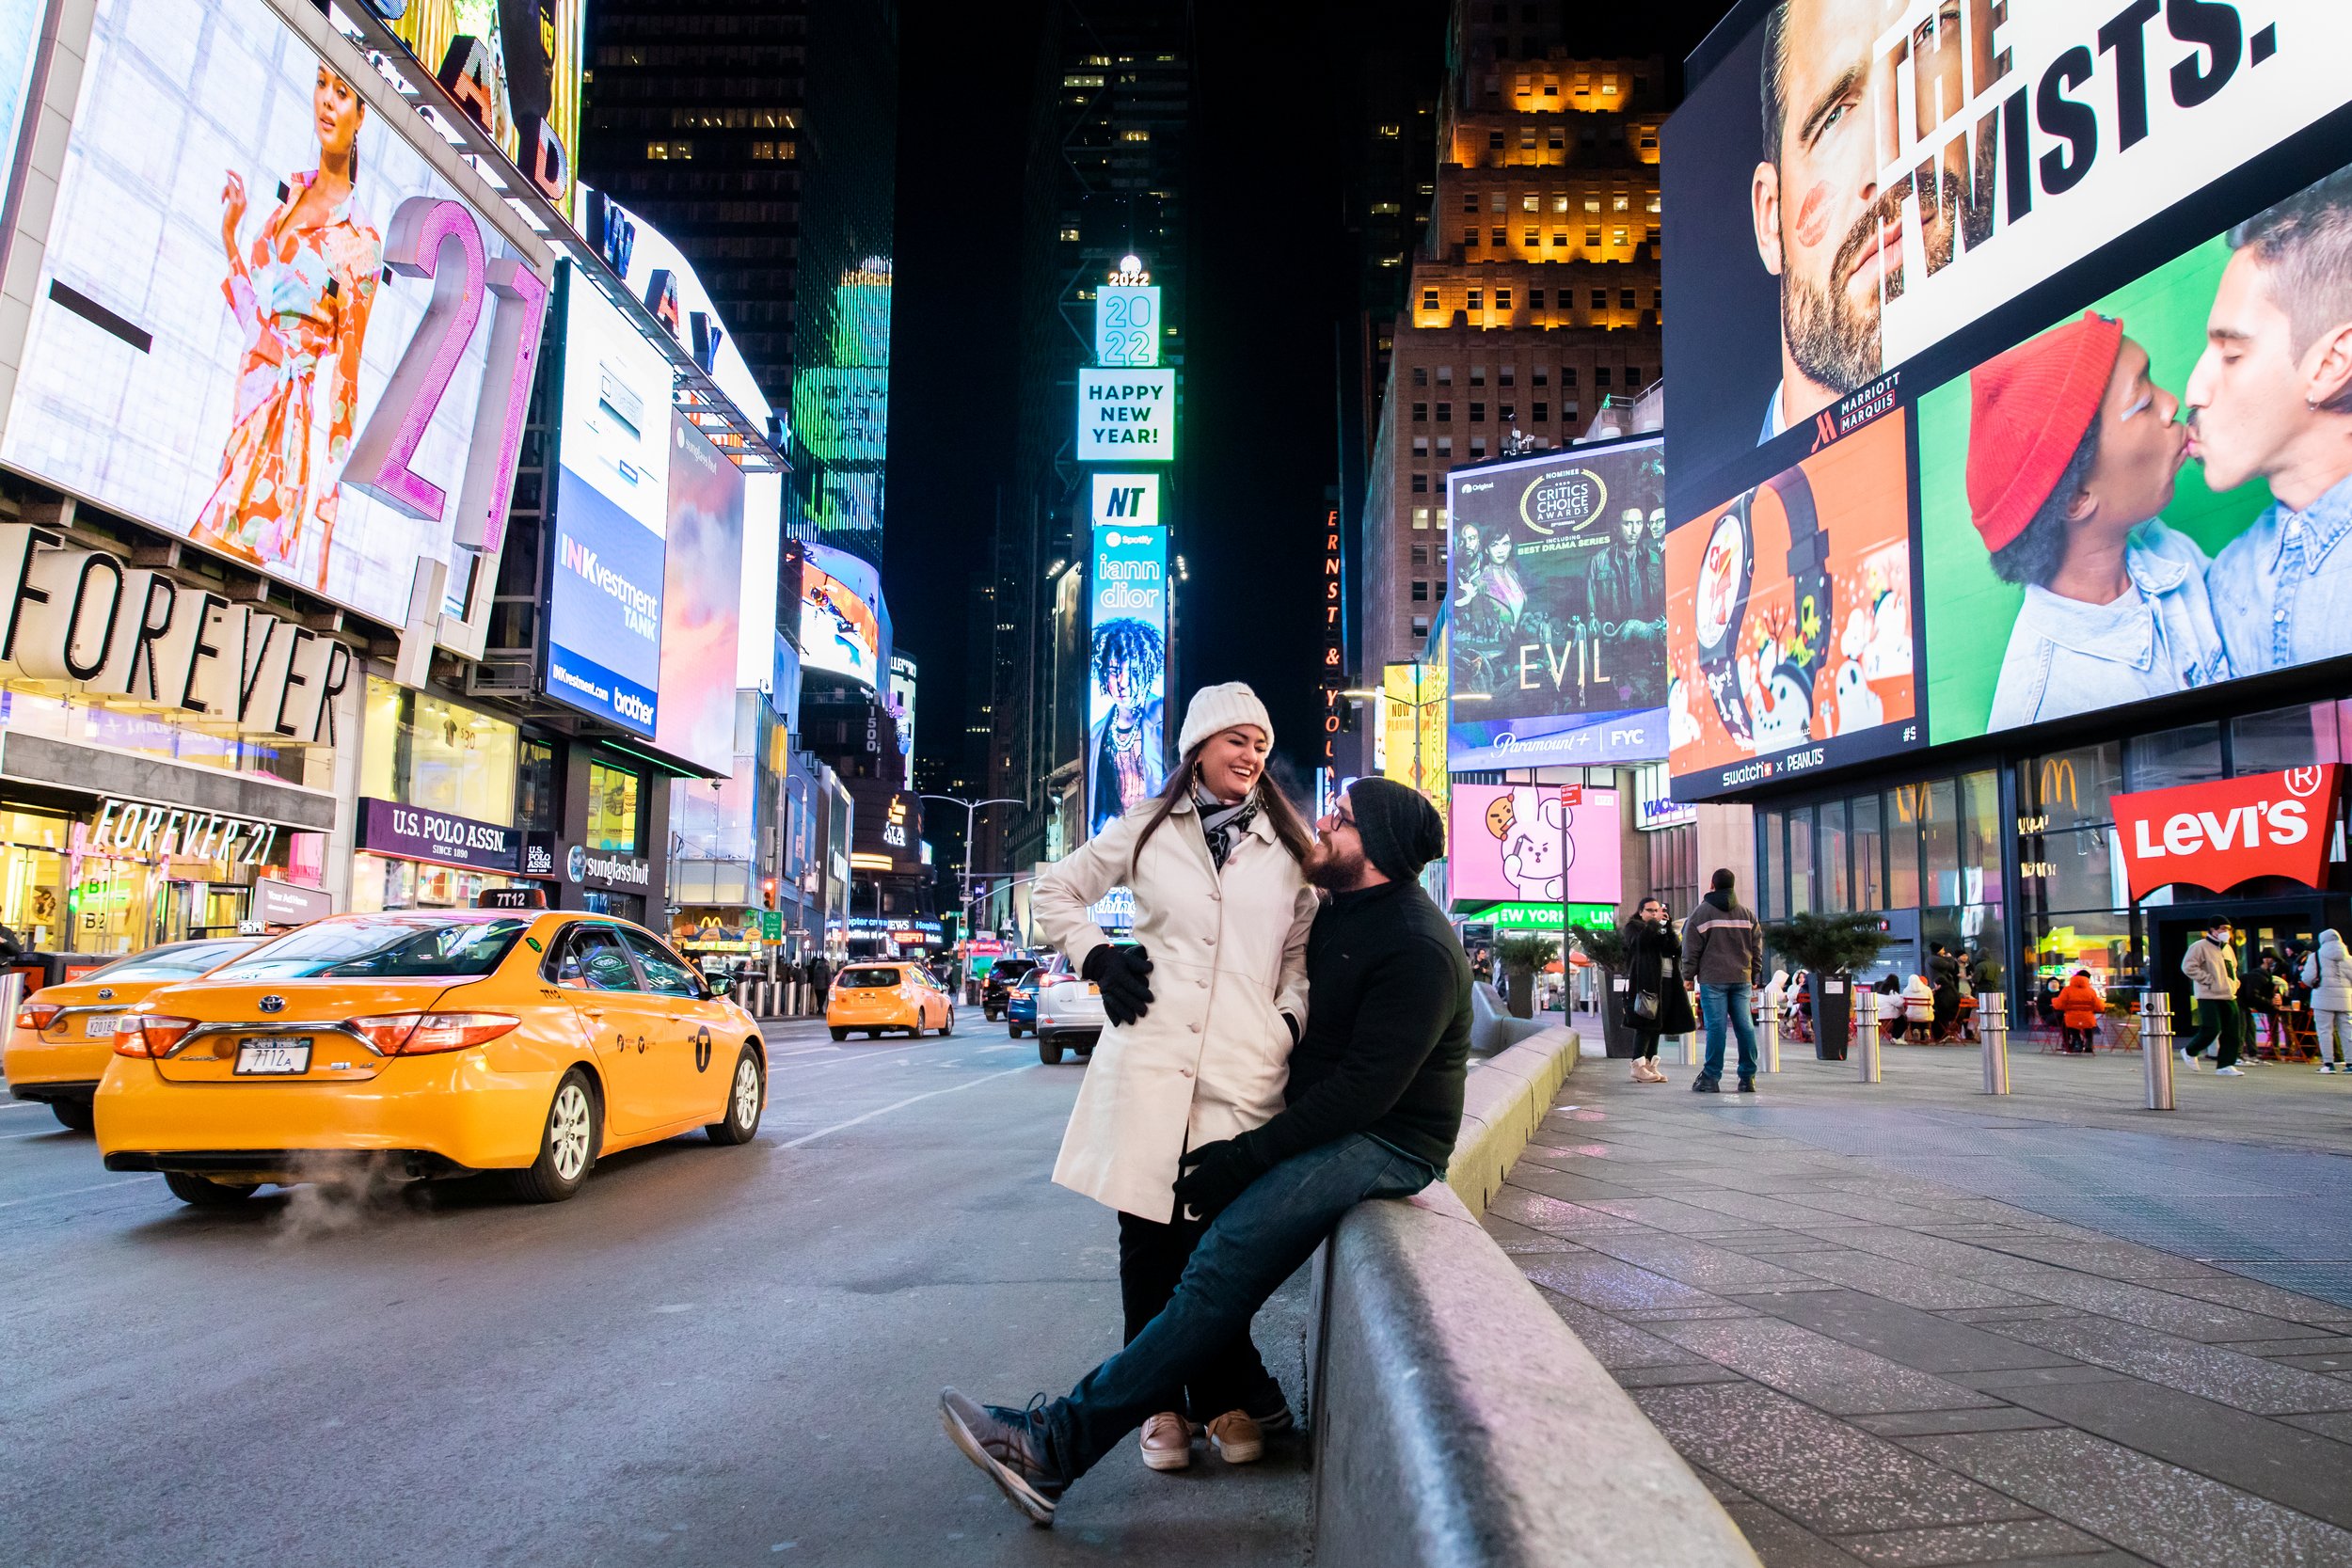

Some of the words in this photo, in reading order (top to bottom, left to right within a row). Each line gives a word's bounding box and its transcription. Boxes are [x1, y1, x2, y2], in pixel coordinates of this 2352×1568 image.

[1875, 0, 2013, 172] THE
[1880, 0, 2277, 306] TWISTS.
[1108, 271, 1150, 286] 2022
[1105, 295, 1151, 328] 20
[1104, 330, 1150, 363] 22
[342, 196, 551, 555] 21
[1089, 385, 1164, 400] HAPPY
[1841, 371, 1900, 416] MARRIOTT
[1101, 406, 1152, 421] NEW
[1841, 393, 1894, 432] MARQUIS
[1092, 428, 1158, 443] YEAR!
[1472, 482, 1494, 492] Original
[1546, 468, 1580, 480] NOMINEE
[1105, 487, 1146, 517] NT
[1536, 483, 1589, 502] CRITICS
[1536, 496, 1589, 514] CHOICE
[1536, 506, 1589, 521] AWARDS
[1122, 534, 1153, 546] Spotify
[1518, 546, 1541, 555] BEST
[1542, 541, 1577, 552] DRAMA
[1578, 536, 1611, 546] SERIES
[1546, 534, 1581, 544] INCLUDING
[561, 532, 658, 622] INKvestment
[1099, 553, 1160, 580] iann
[1326, 511, 1340, 625] ERNST
[1100, 581, 1159, 609] dior
[1, 526, 352, 749] FOREVER
[623, 607, 656, 642] TANK
[1519, 639, 1611, 696] EVIL
[552, 663, 609, 702] INKvestment.com
[613, 687, 654, 726] brother
[1392, 704, 1410, 717] NOW
[460, 727, 476, 751] $30
[866, 706, 877, 752] 1500
[1387, 720, 1415, 732] PLAYING
[1490, 732, 1590, 758] Paramount+
[1611, 729, 1645, 746] FYC
[1723, 761, 1765, 786] swatch
[1787, 748, 1824, 772] PEANUTS
[92, 800, 240, 860] FOREVER
[243, 824, 277, 865] 21
[392, 809, 420, 837] U.S.
[423, 816, 464, 845] POLO
[466, 827, 506, 853] ASSN.
[433, 844, 452, 857] SINCE
[453, 847, 469, 859] 1890
[588, 855, 631, 886] sunglass
[631, 864, 649, 886] hut
[497, 893, 526, 907] 7T12
[894, 932, 924, 942] ESPN
